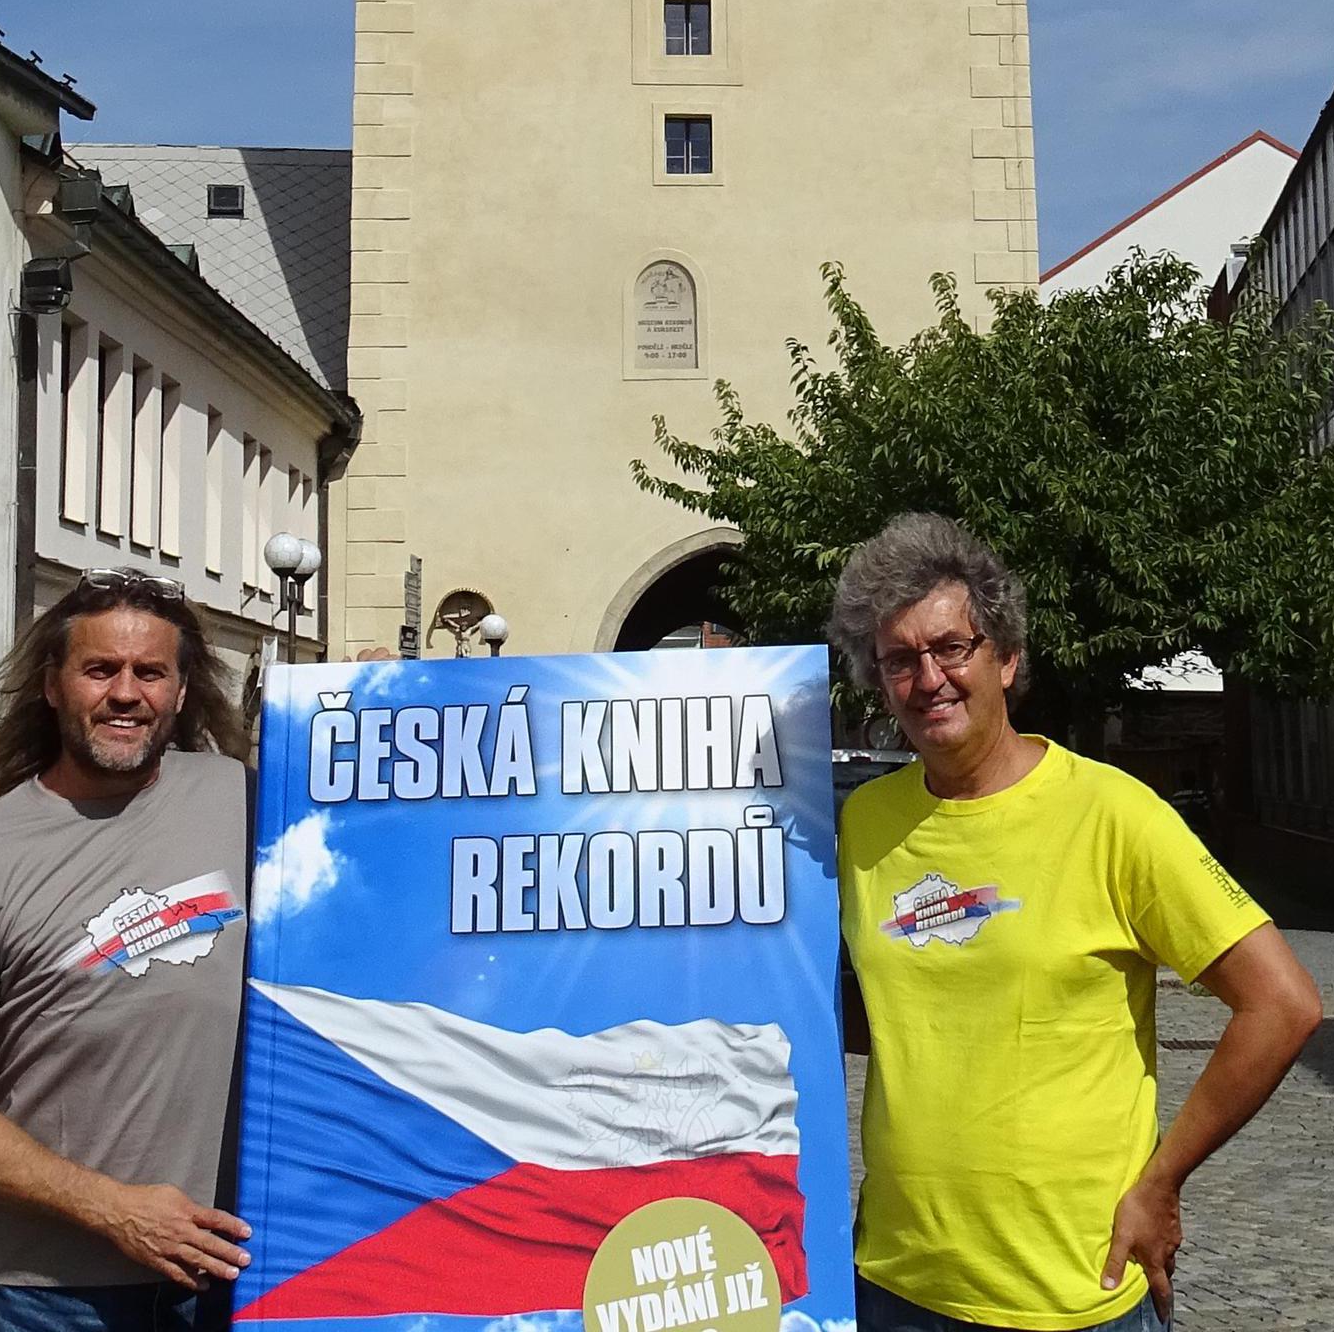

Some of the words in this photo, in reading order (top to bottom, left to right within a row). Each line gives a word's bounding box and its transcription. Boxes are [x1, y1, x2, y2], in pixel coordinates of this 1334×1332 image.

[308, 686, 538, 803] ČESKÁ
[560, 694, 784, 795] KNIHA
[451, 805, 786, 935] REKORDŮ
[113, 898, 158, 933] ČESKÁ
[119, 917, 165, 946] KNIHA
[126, 920, 191, 959] REKORDŮ
[631, 1225, 717, 1286] NOVÉ
[595, 1273, 719, 1332] VYDÁNÍ
[724, 1261, 768, 1315] JIŽ
